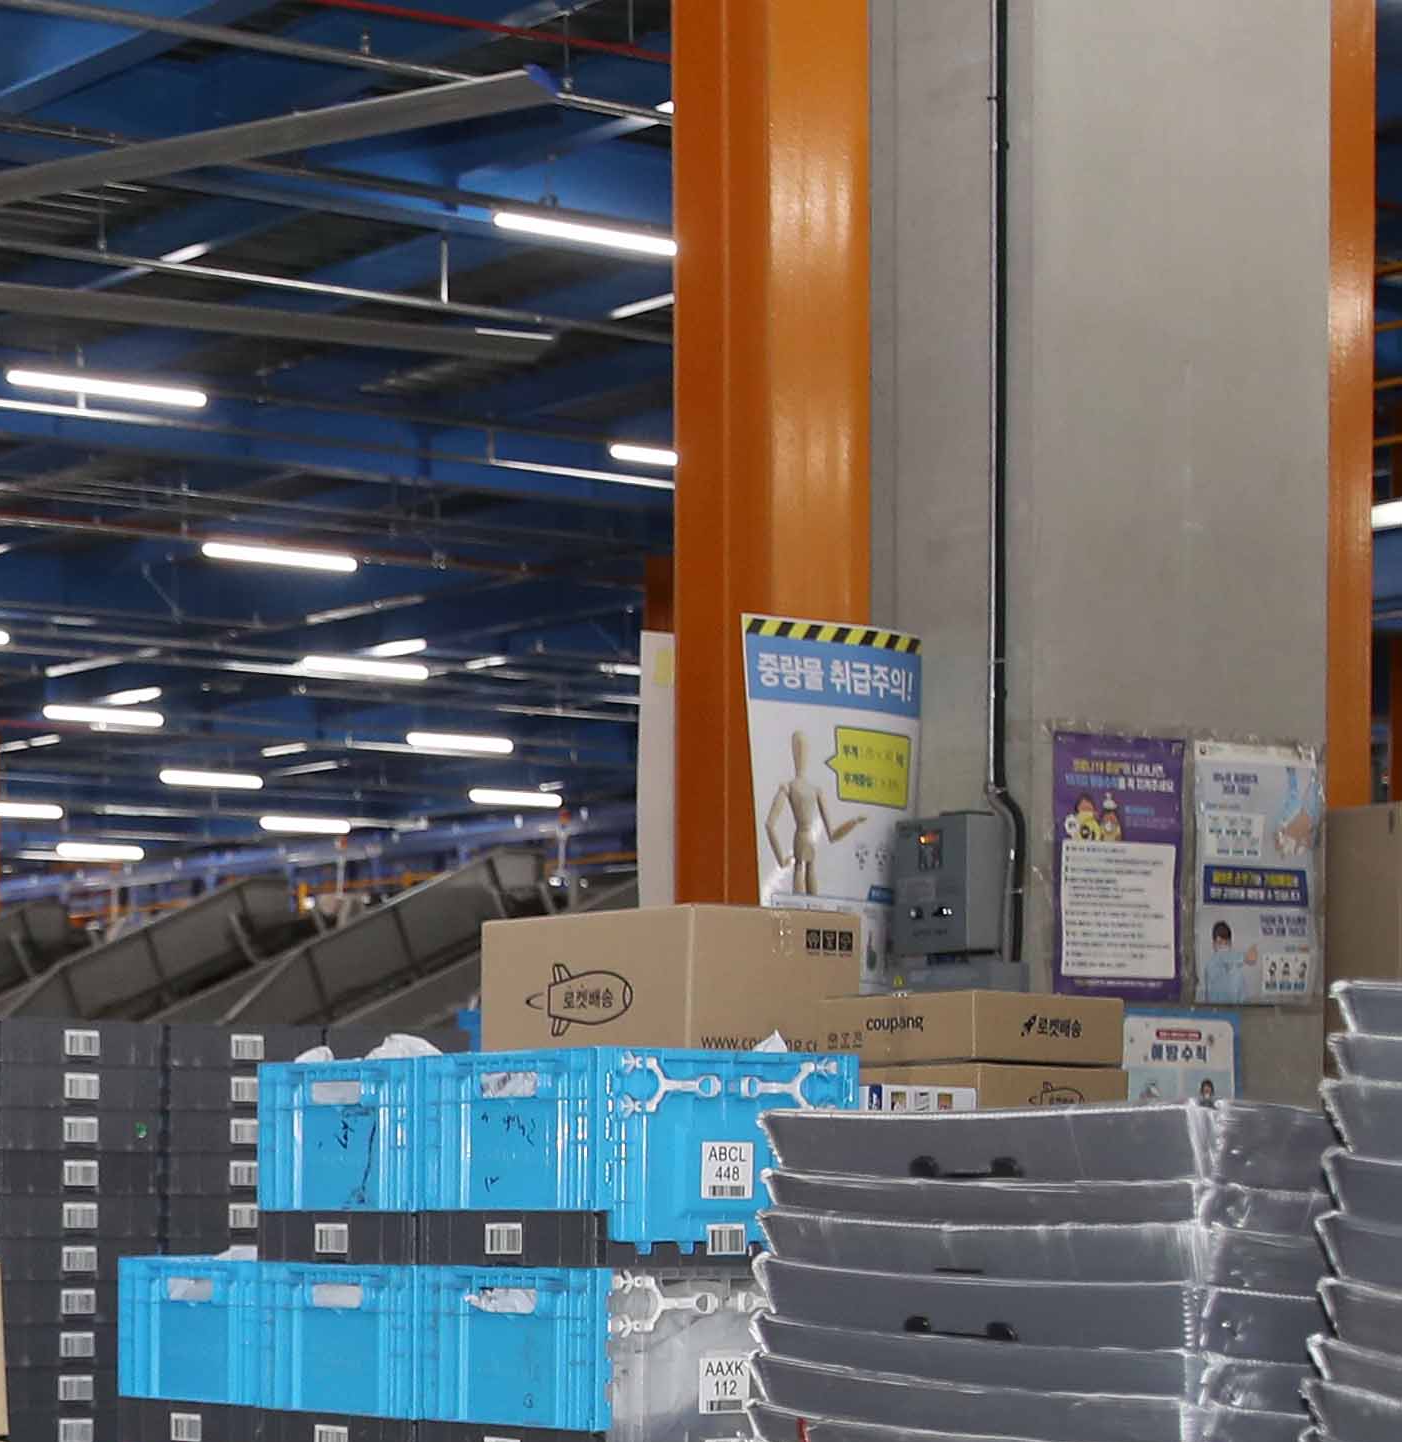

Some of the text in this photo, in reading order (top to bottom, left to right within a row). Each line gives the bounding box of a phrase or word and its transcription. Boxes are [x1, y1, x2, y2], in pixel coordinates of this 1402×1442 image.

[757, 652, 913, 701] 중량물 취급주의!
[562, 987, 614, 1009] 로켓배송
[866, 1014, 924, 1033] coupang
[1036, 1016, 1083, 1038] 로켓배송
[708, 1146, 746, 1162] ABCL
[715, 1166, 740, 1181] 448
[705, 1360, 744, 1376] AAXK
[714, 1380, 737, 1396] 112
